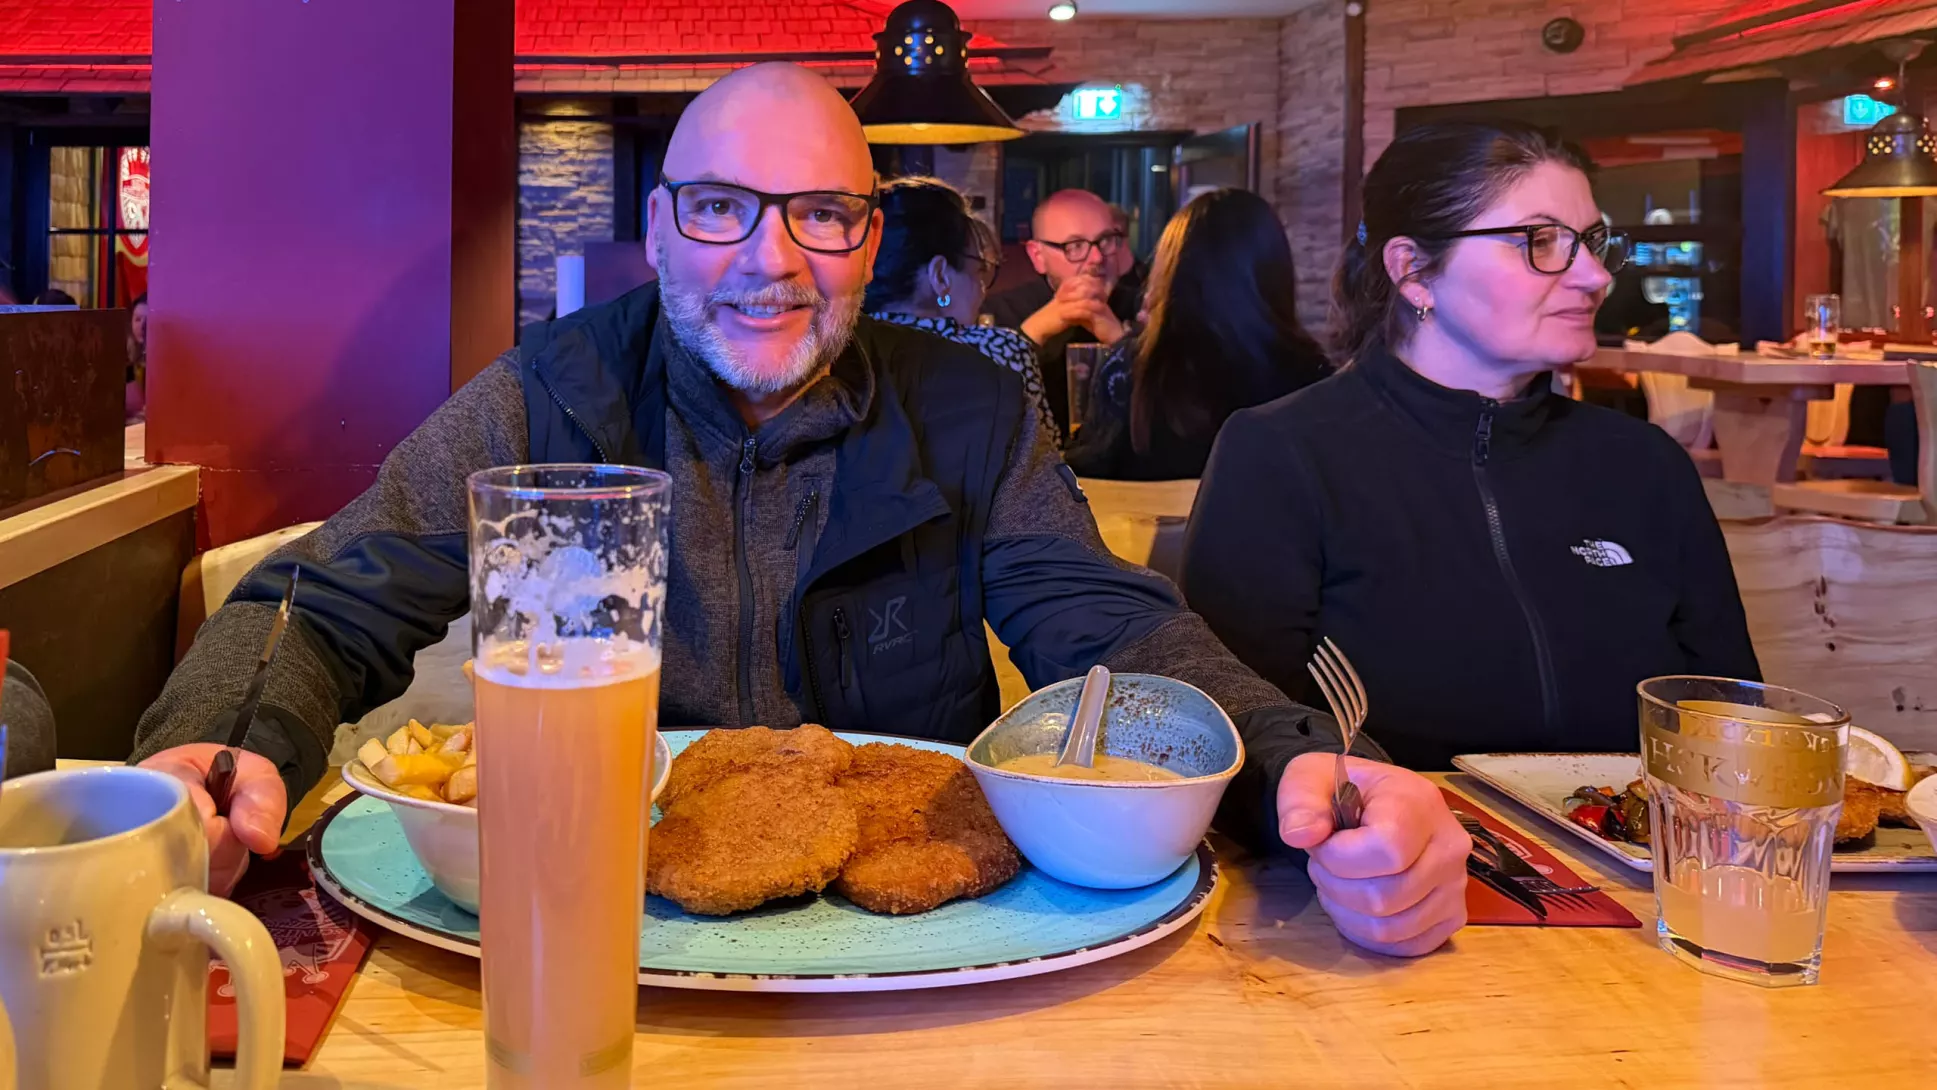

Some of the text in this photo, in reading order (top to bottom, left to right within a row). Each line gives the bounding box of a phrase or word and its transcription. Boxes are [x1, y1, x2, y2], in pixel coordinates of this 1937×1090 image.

[1583, 539, 1604, 550] THE
[1569, 546, 1606, 558] NORTH
[1584, 555, 1613, 567] FACE
